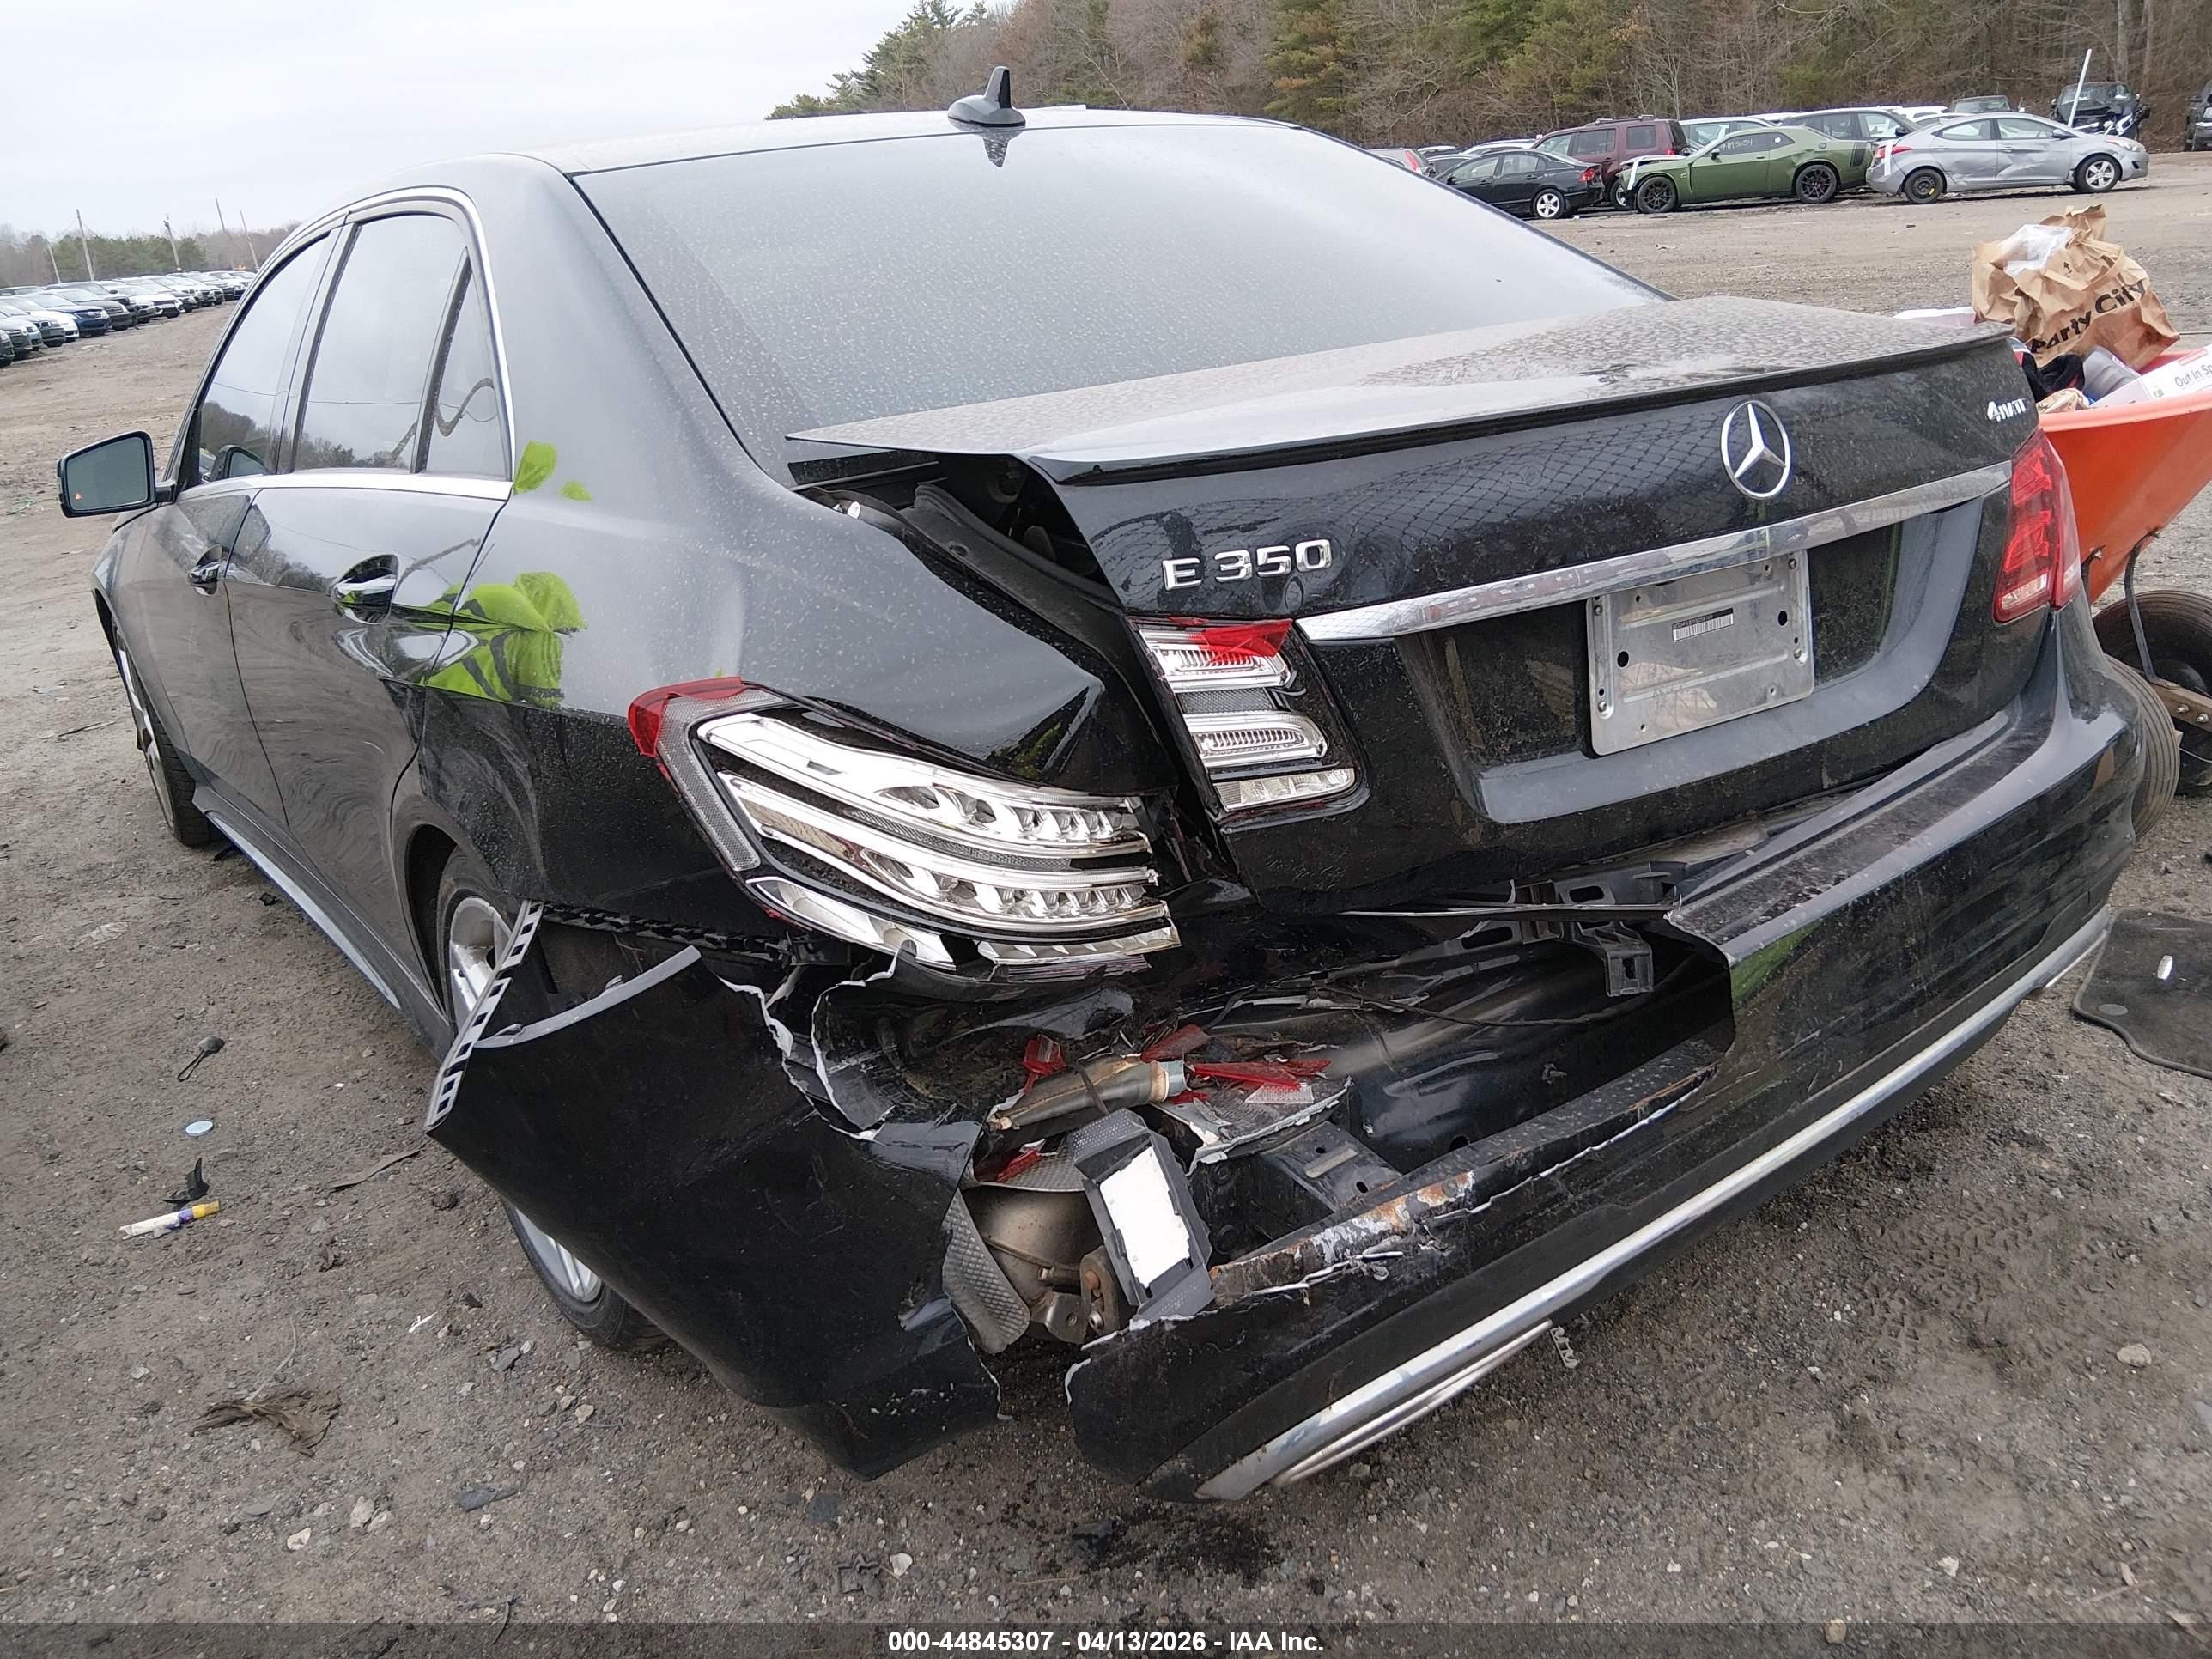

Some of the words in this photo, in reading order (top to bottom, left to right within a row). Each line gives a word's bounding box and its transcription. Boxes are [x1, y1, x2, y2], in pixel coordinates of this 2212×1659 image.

[2030, 310, 2092, 353] Party
[2094, 275, 2146, 314] City
[2174, 372, 2192, 387] Out
[1161, 557, 1203, 591] E
[1213, 538, 1333, 583] 350
